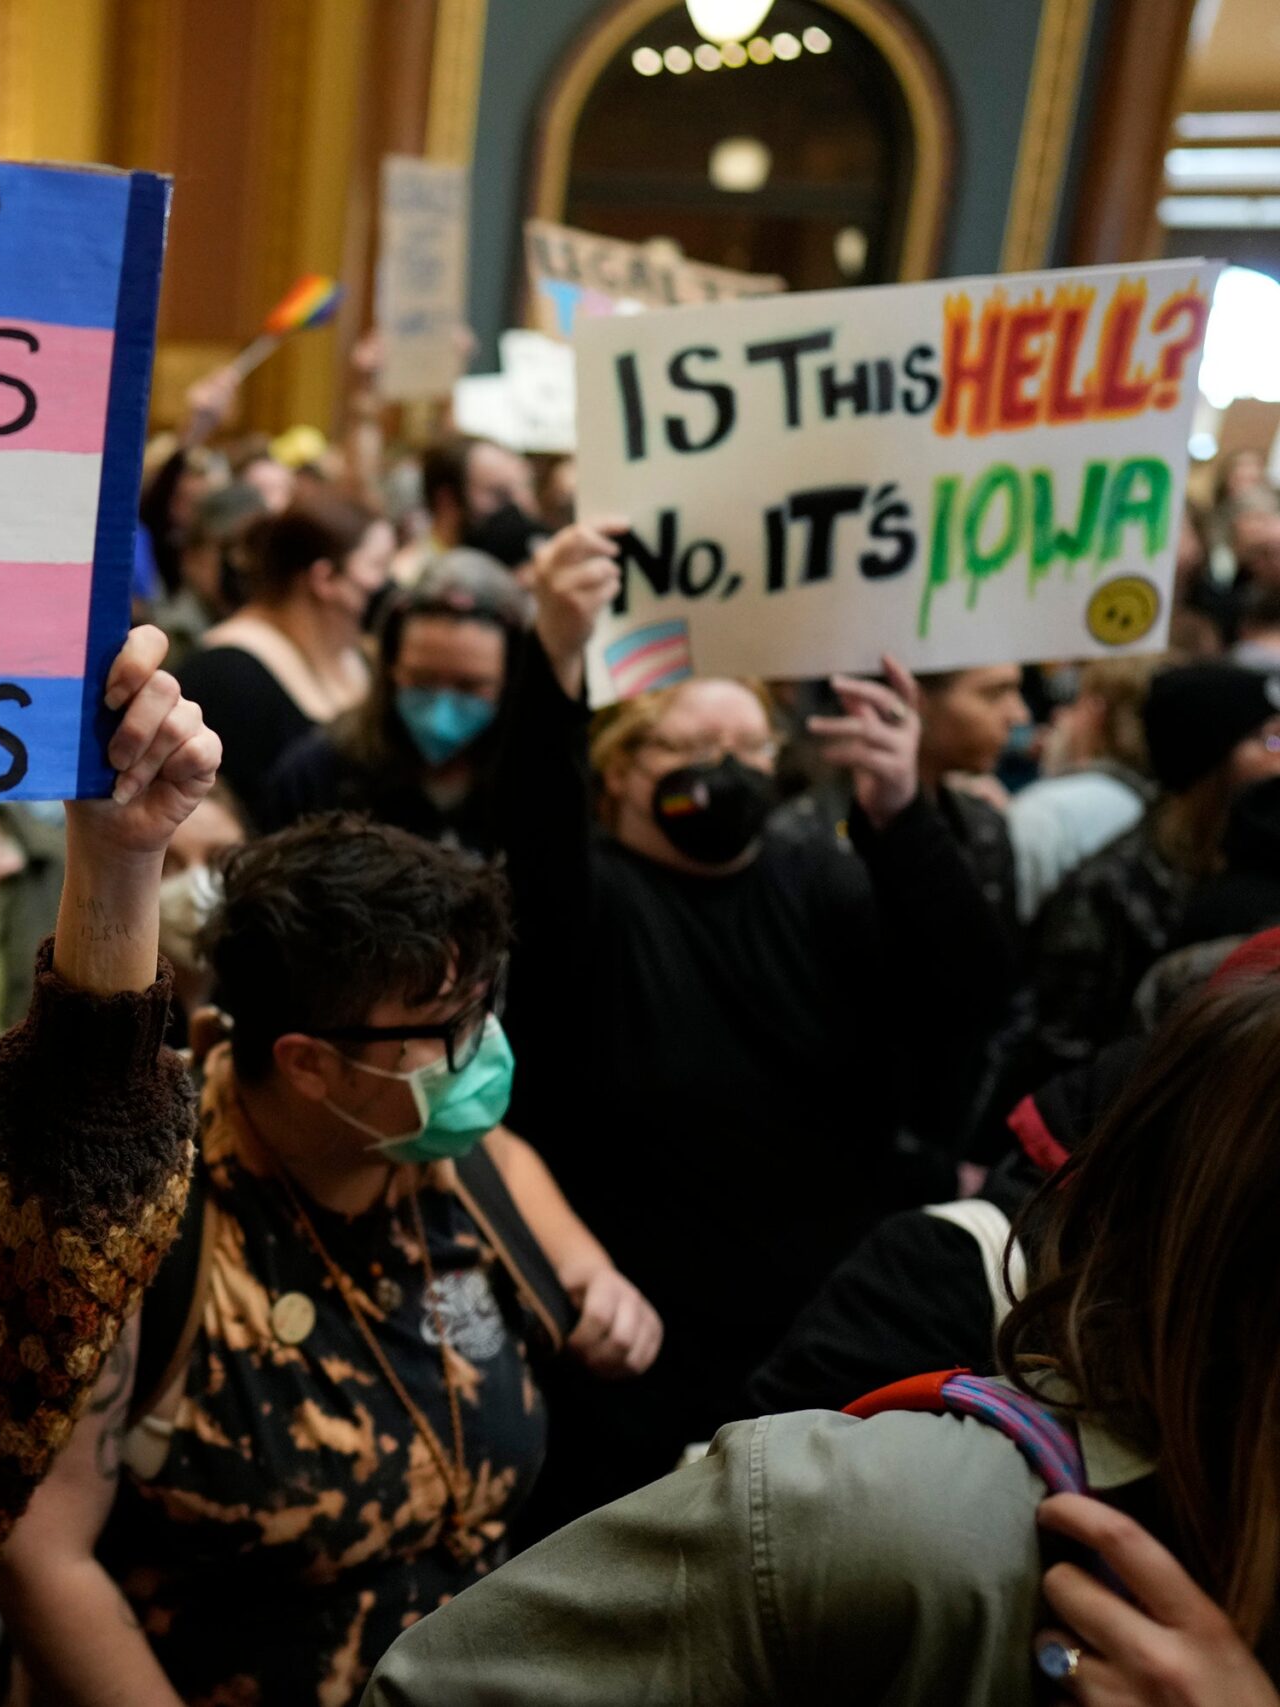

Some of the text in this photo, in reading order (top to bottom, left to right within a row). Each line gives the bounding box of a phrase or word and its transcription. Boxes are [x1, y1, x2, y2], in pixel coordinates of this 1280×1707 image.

[616, 345, 737, 461] IS
[744, 329, 941, 430] THIS
[933, 275, 1209, 438] HELL?
[918, 454, 1173, 637] IOWA
